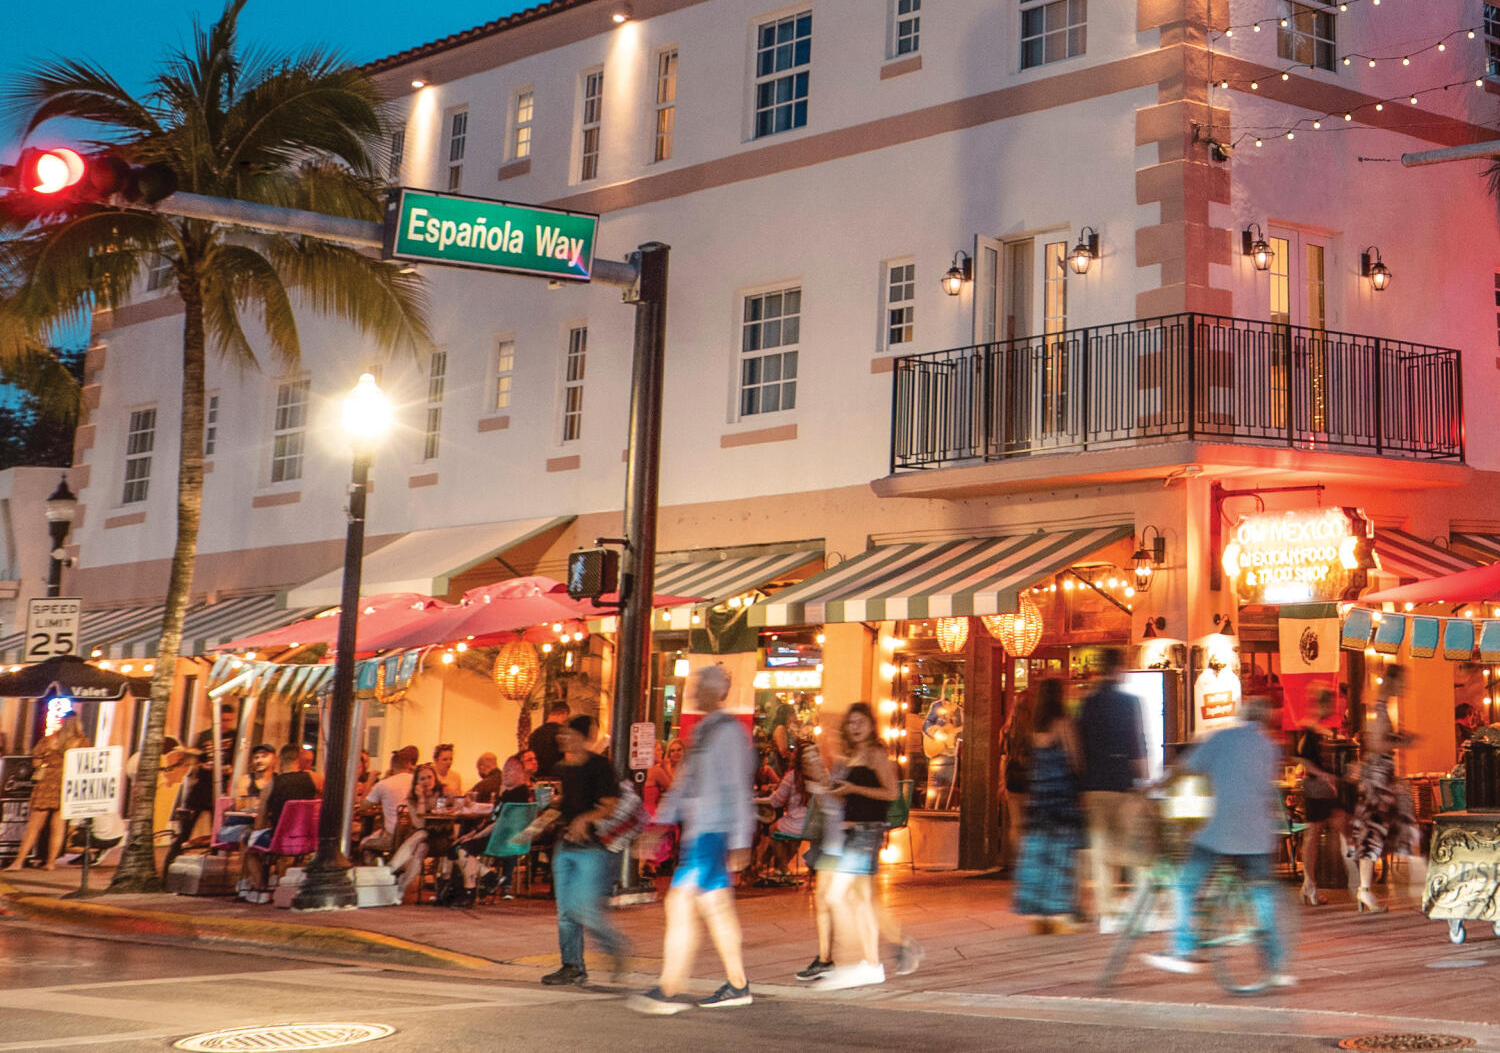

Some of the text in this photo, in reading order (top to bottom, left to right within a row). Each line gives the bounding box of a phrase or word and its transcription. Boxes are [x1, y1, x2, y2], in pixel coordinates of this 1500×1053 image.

[407, 207, 584, 268] Española Way
[1270, 519, 1343, 543] MEXICO
[1240, 545, 1337, 568] MEXICAN FOOD
[1258, 566, 1292, 584] TACO
[1294, 564, 1329, 582] SHOP
[32, 604, 77, 615] SPEED
[36, 618, 72, 628] LIMIT
[30, 632, 74, 656] 25
[70, 686, 108, 697] Valet
[76, 750, 111, 774] VALET
[65, 777, 117, 803] PARKING
